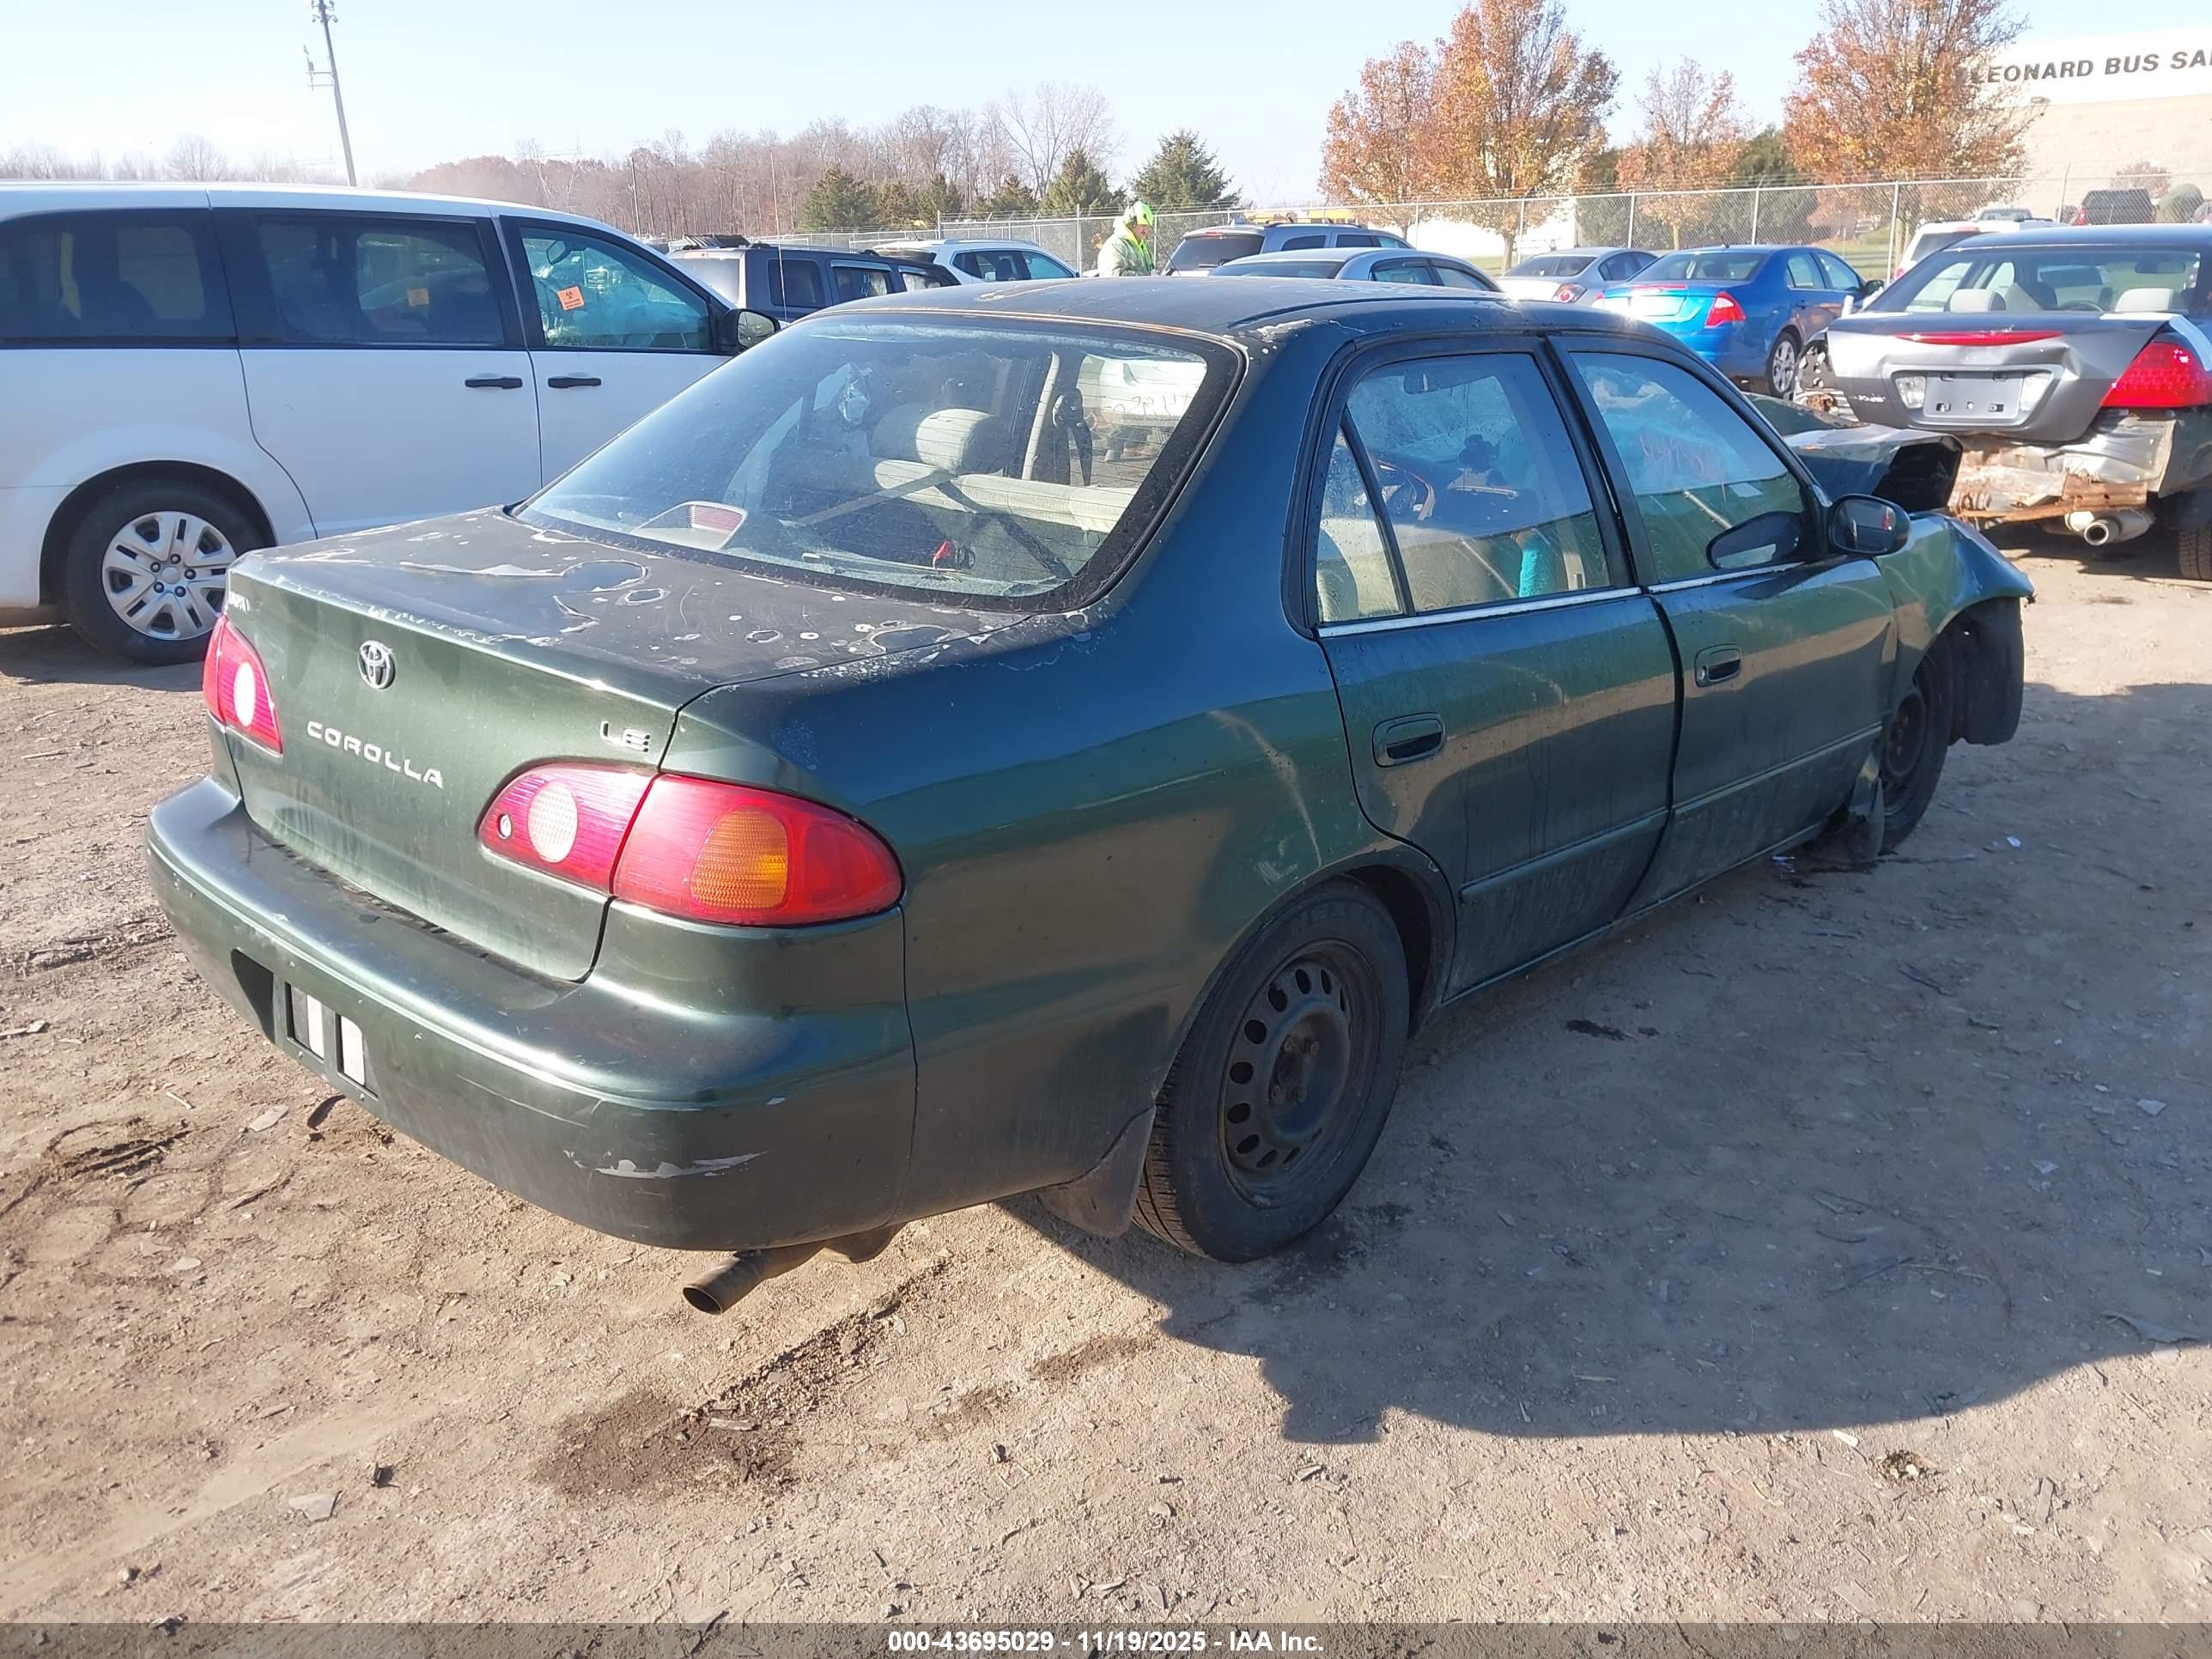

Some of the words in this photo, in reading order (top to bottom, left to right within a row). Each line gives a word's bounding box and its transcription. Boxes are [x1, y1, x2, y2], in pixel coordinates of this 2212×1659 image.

[2105, 53, 2160, 76] BUS
[2170, 49, 2212, 70] SA
[599, 720, 651, 753] LE
[307, 720, 444, 789] COROLLA
